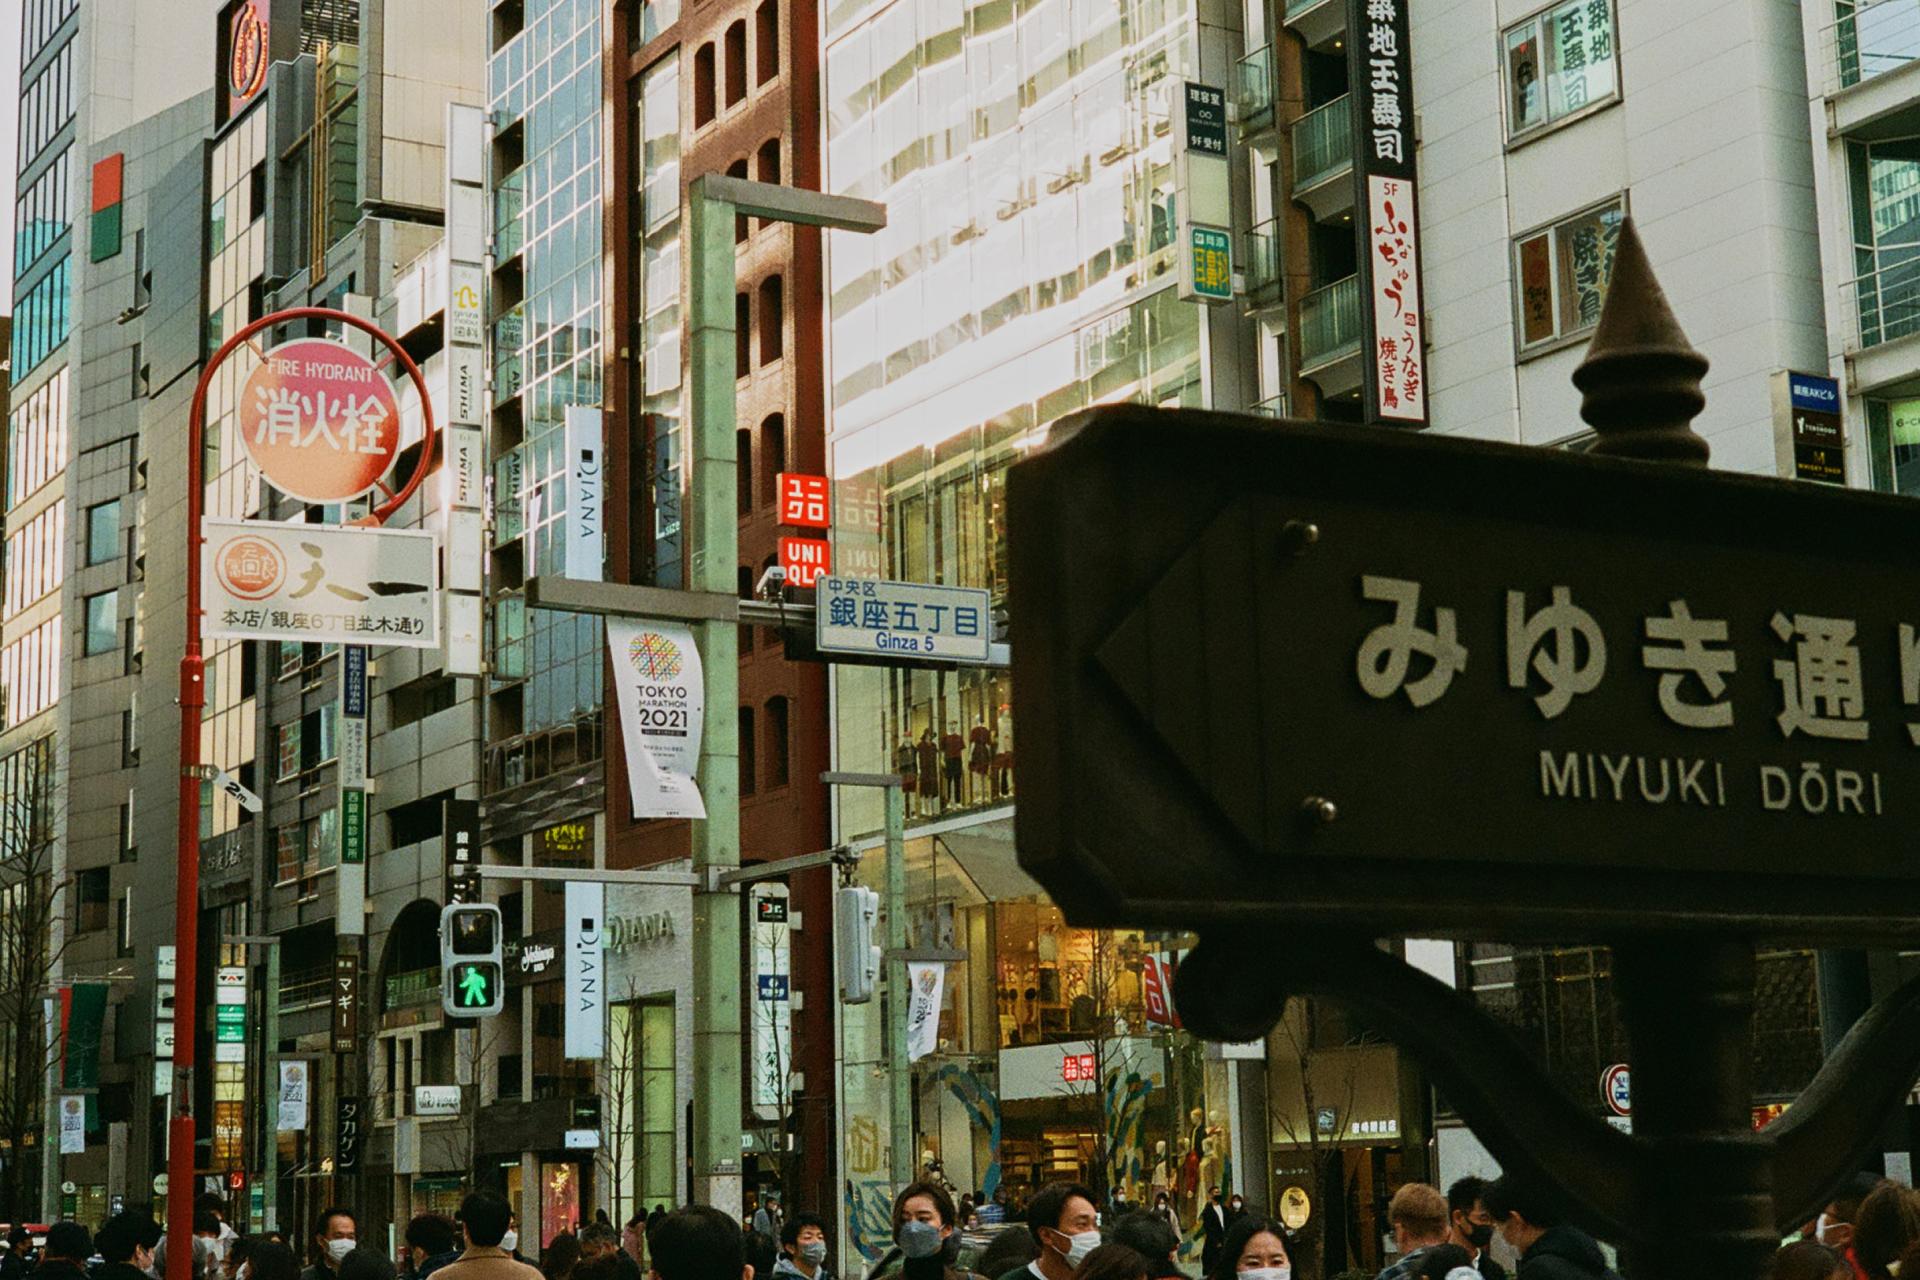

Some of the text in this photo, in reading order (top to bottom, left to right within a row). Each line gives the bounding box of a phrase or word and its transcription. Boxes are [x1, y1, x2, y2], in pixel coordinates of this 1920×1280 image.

[1190, 89, 1220, 106] 理容室
[1383, 182, 1399, 196] 5F
[268, 360, 373, 383] FIRE HYDRANT
[1379, 336, 1398, 409] 焼き鳥
[1401, 330, 1420, 402] うなぎ
[460, 365, 469, 420] SHIMA
[255, 385, 389, 455] 消火栓
[459, 447, 468, 503] SHIMA
[577, 449, 599, 538] DIANA
[788, 479, 823, 499] ユニ
[787, 501, 824, 521] クロ
[788, 542, 823, 564] UNI
[828, 579, 877, 597] 中央区
[829, 596, 978, 636] 銀座五丁目
[876, 631, 934, 652] Ginza 5
[636, 685, 687, 699] TOKYO
[638, 700, 687, 708] MARATHON
[639, 708, 687, 728] 2021
[1540, 751, 1726, 806] MIYUKI
[225, 781, 247, 804] 2m
[347, 791, 359, 859] 西銀座診療所
[577, 918, 600, 1012] DIANA
[338, 978, 353, 1027] マギー
